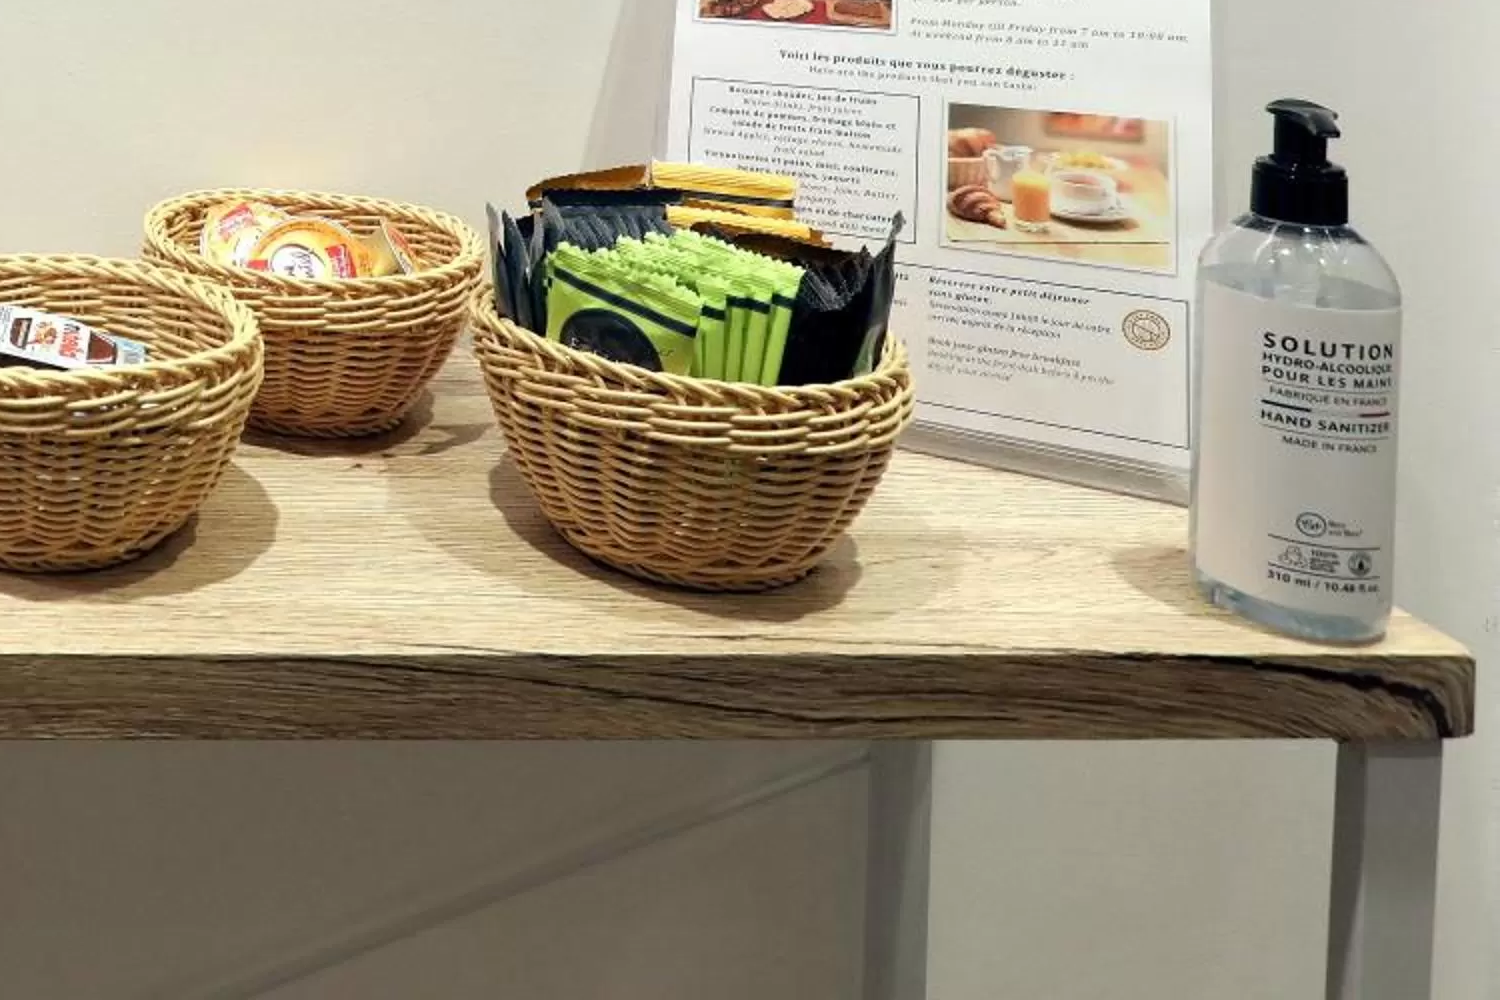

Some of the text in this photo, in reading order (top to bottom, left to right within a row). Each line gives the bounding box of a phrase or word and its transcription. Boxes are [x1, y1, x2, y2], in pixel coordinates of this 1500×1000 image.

[780, 48, 809, 61] Voici
[813, 50, 829, 62] les
[833, 53, 886, 67] produits
[889, 58, 913, 69] que
[916, 61, 947, 72] vous
[949, 62, 1003, 76] pourrez
[1006, 65, 1067, 80] déguster
[1263, 331, 1393, 361] SOLUTION
[1262, 351, 1392, 376] HYDRO-ALCOOLIQUE
[1261, 364, 1310, 384] POUR
[1317, 375, 1347, 389] LES
[1333, 396, 1351, 407] EN
[1260, 408, 1390, 435] HAND SANITIZER
[1281, 435, 1378, 455] MADE IN FRANCE
[1295, 577, 1312, 590] ml
